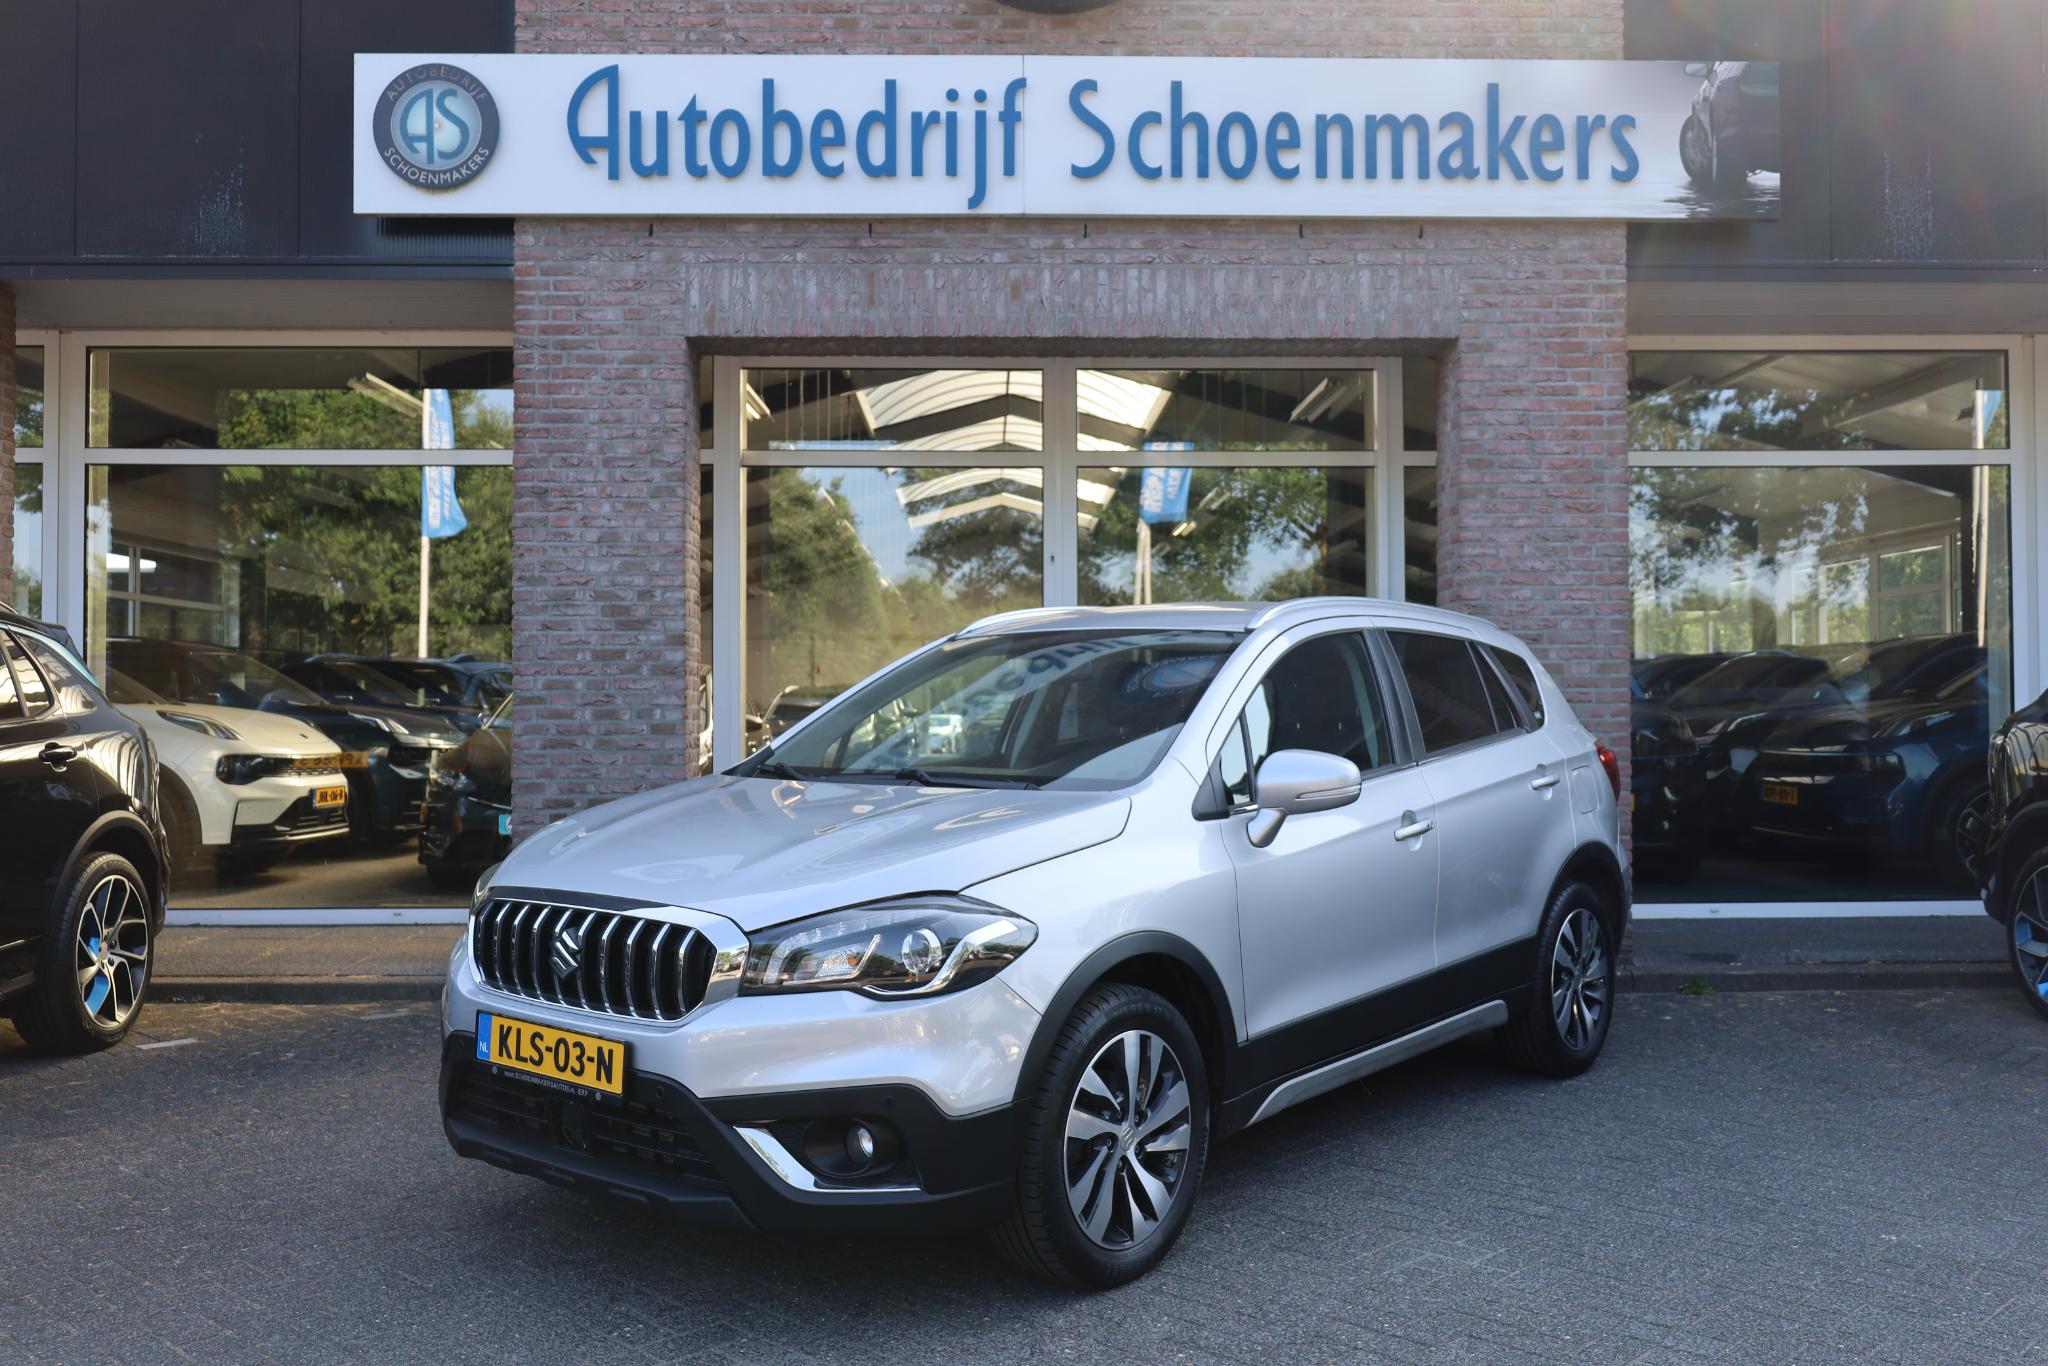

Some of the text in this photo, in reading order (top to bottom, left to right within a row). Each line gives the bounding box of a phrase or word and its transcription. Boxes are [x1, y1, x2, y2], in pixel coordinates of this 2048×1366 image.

[386, 65, 488, 102] AUTOBEDRIJF
[400, 88, 470, 164] AS
[567, 64, 1638, 209] Autobedrijf Schoenmakers
[384, 147, 489, 184] SCHOENMAKERS
[479, 1041, 489, 1054] NL
[498, 1024, 613, 1084] KLS-03-N
